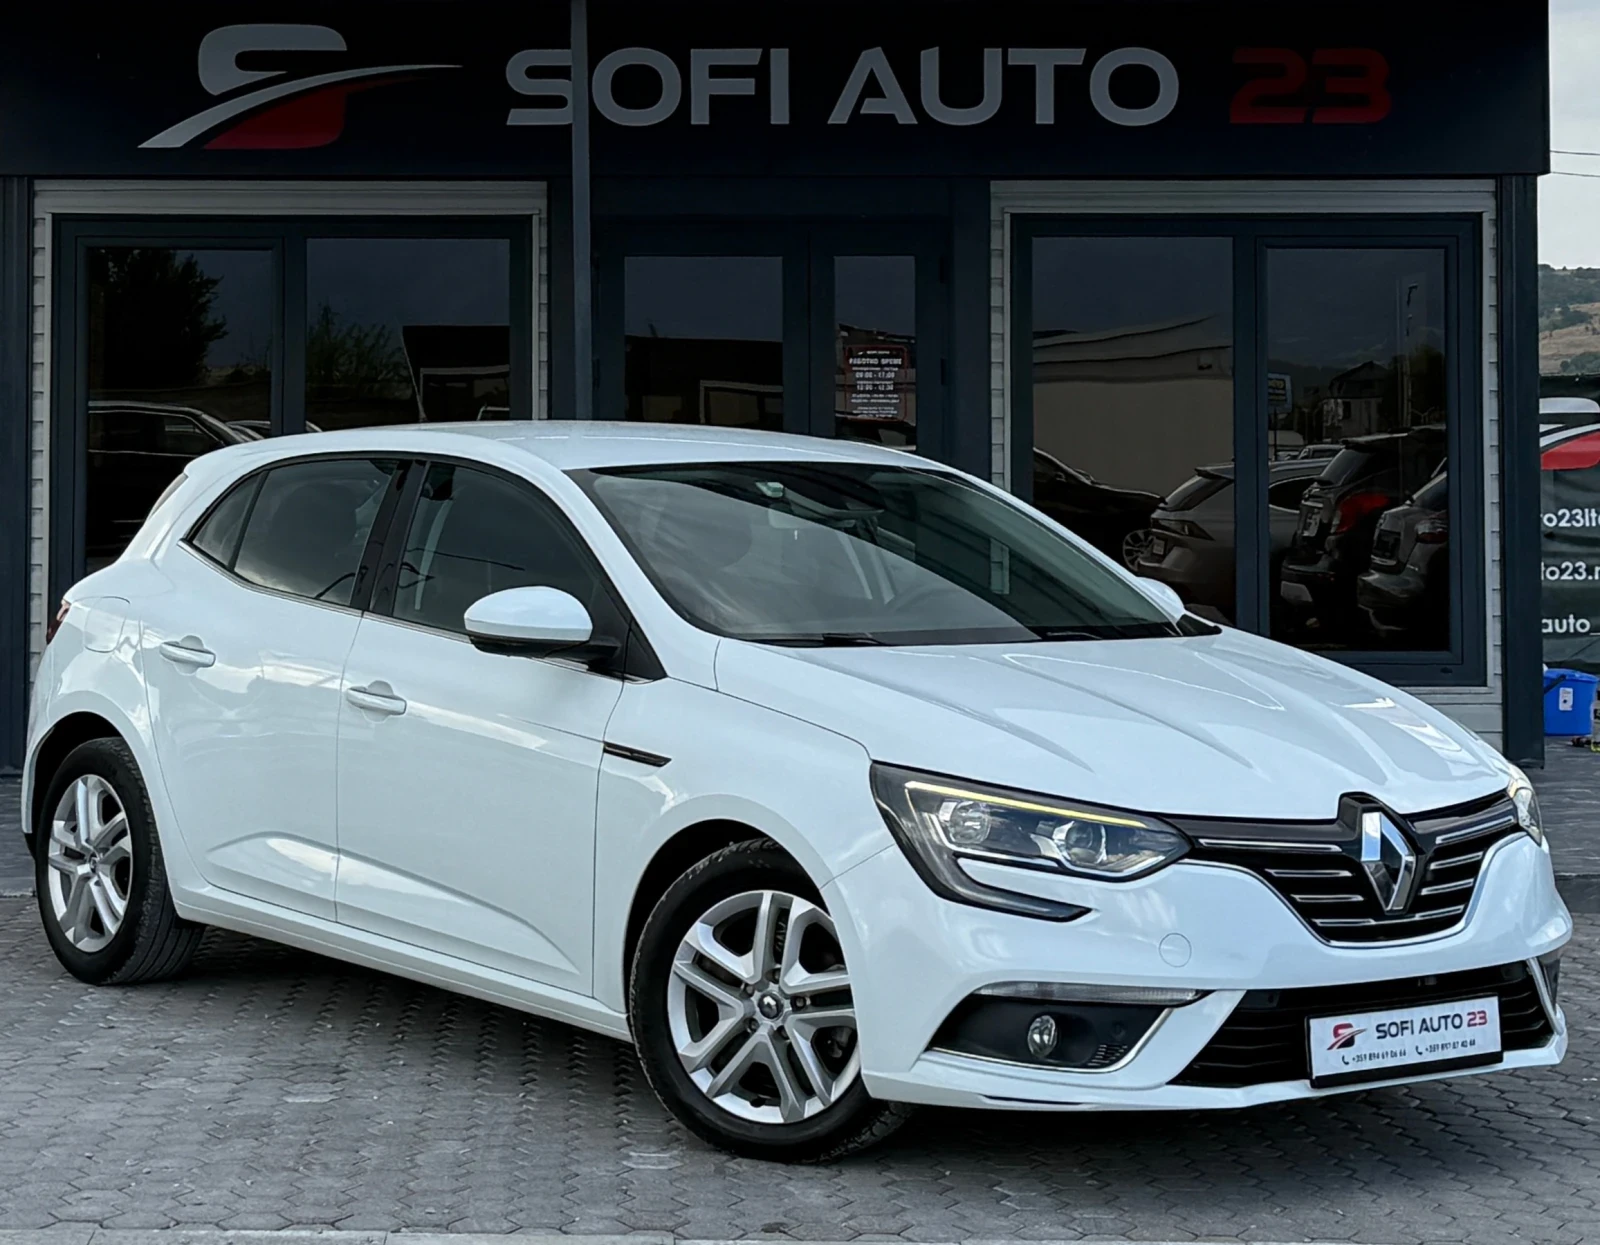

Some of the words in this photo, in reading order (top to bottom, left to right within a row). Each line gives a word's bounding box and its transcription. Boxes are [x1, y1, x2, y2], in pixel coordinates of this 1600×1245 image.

[505, 47, 790, 127] SOFI
[826, 46, 1180, 127] AUTO
[1229, 46, 1394, 124] 23
[1540, 508, 1600, 527] o23lt
[1375, 1019, 1414, 1040] SOFI
[1418, 1013, 1463, 1035] AUTO
[1466, 1010, 1488, 1028] 23
